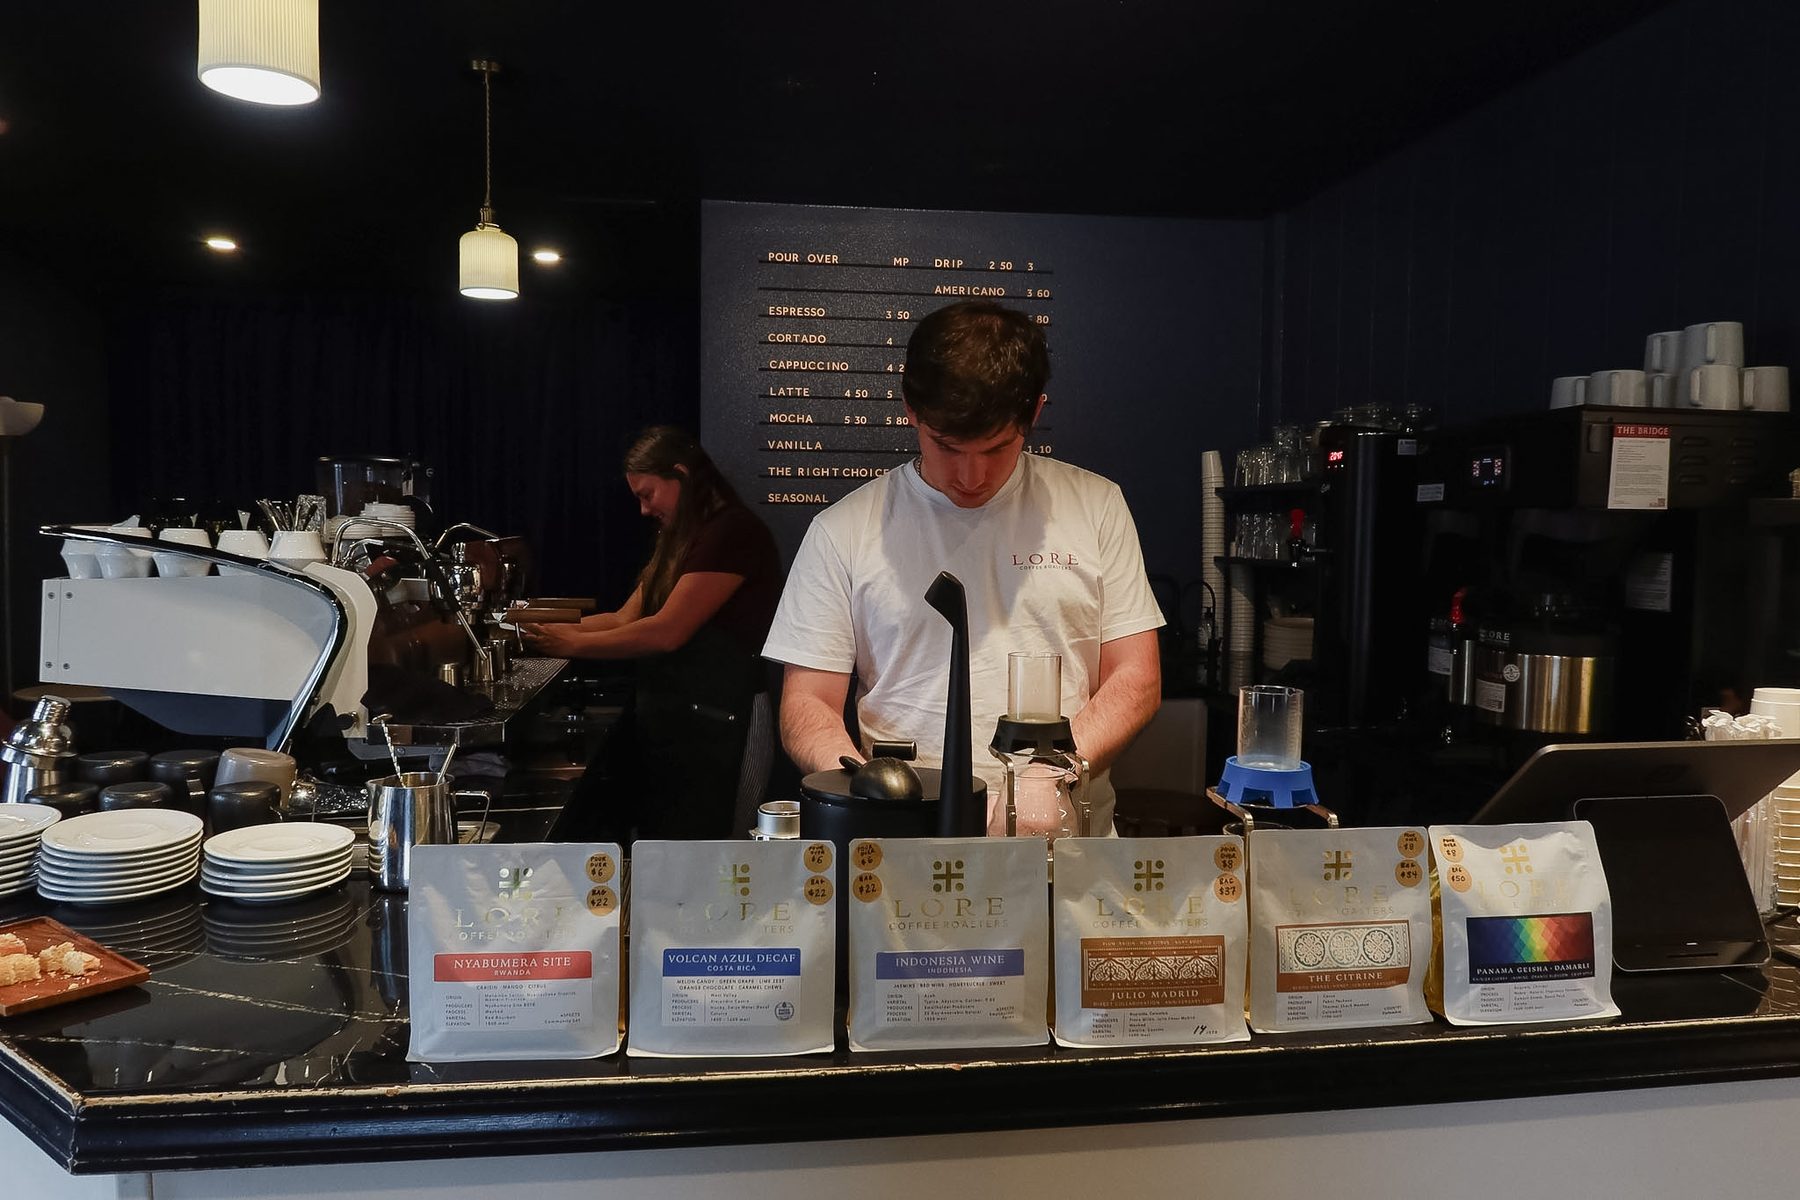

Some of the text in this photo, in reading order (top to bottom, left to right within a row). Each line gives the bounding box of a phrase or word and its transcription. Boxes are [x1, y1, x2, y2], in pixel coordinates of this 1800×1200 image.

[768, 252, 910, 267] POUR OVER MP
[934, 259, 1034, 271] DRIP 2 50 3
[934, 286, 1050, 298] AMERICANO 3 60
[769, 306, 910, 320] ESPRESSO 3 50
[1036, 315, 1050, 324] 80
[768, 334, 893, 346] CORTADO 4
[769, 360, 849, 372] CAPPUCCINO
[887, 364, 893, 373] 4
[770, 387, 893, 399] LATTE 4 50 5
[769, 414, 909, 426] MOCHA 5 30 5 80
[1617, 426, 1635, 434] THE
[768, 440, 822, 450] VANILLA
[1028, 446, 1052, 454] 1.10
[768, 466, 792, 476] THE
[798, 467, 840, 477] RIGHT
[768, 494, 828, 503] SEASONAL
[1012, 552, 1078, 566] LORE
[808, 888, 826, 897] $22
[859, 884, 876, 894] $22
[1220, 886, 1236, 895] $37
[591, 898, 608, 906] $22
[1096, 896, 1204, 916] LOE
[895, 898, 1004, 918] LORE
[889, 920, 1008, 930] COFFEE ROASTERS
[454, 956, 571, 969] NYABUMERA SITE
[668, 954, 796, 964] VOLCAN AZUL DECAF
[896, 955, 1005, 967] INDONESIA WINE
[1554, 963, 1590, 971] DAMARLI
[1336, 972, 1383, 981] CITRINE
[1111, 990, 1199, 1001] JULIO MADRID
